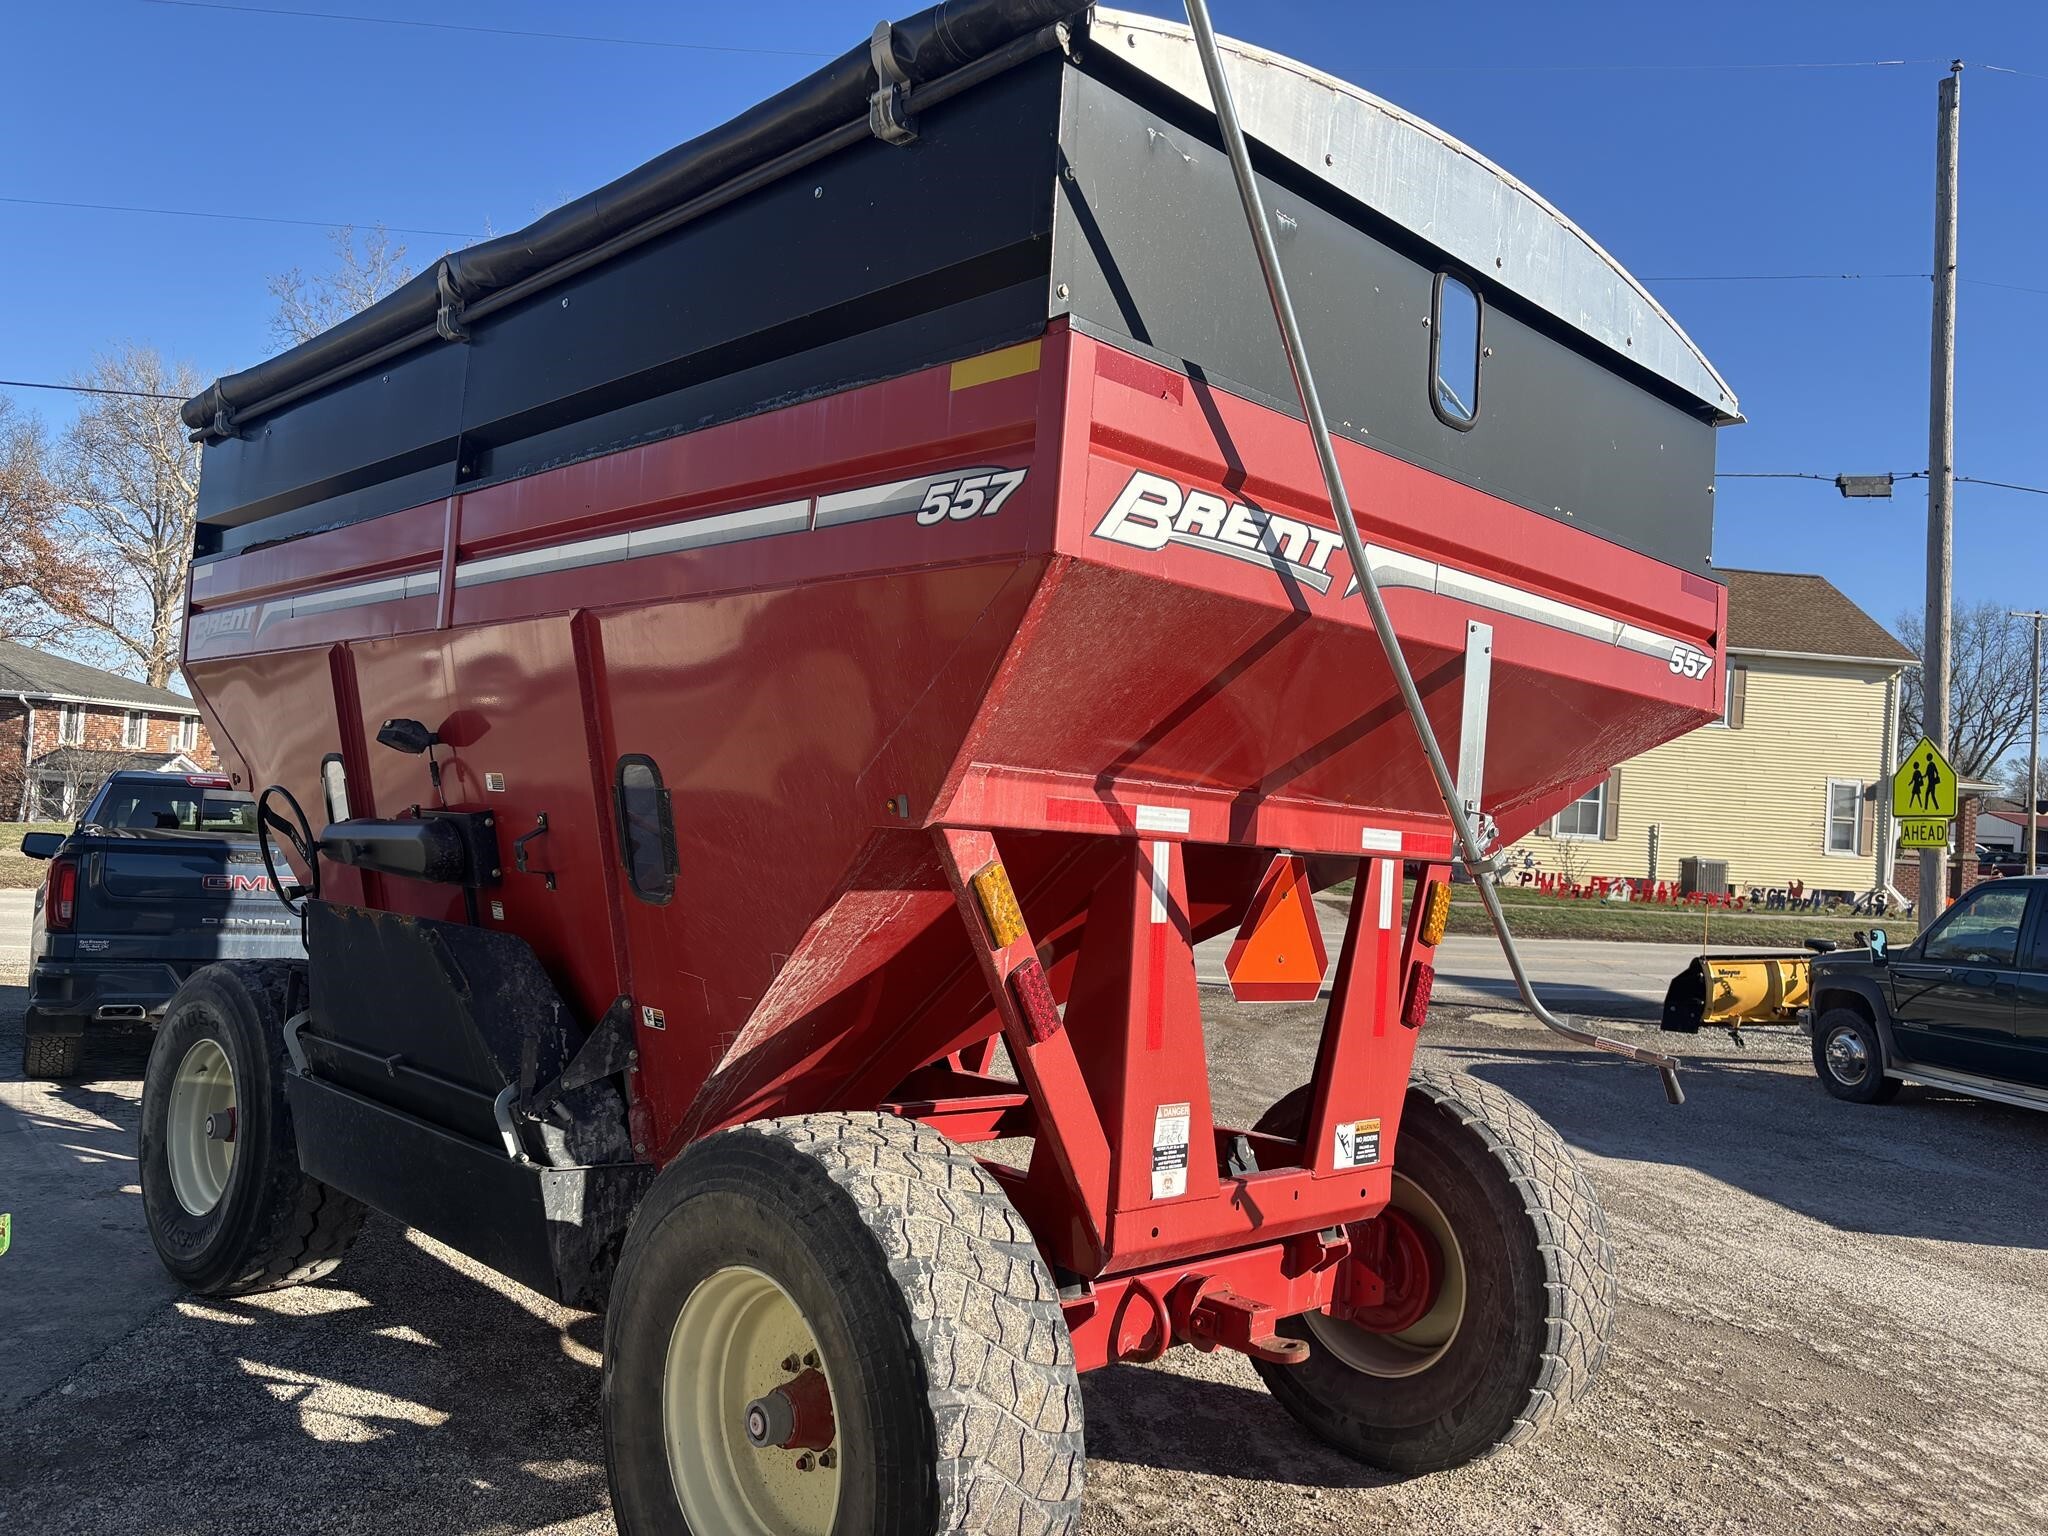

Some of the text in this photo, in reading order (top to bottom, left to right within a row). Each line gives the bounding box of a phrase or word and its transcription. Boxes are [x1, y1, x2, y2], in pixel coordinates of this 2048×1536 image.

[916, 466, 1030, 526] 557
[1669, 646, 1713, 681] 557
[1903, 825, 1945, 841] AHEAD
[201, 918, 290, 927] DENALI
[1163, 1107, 1189, 1118] DANGER
